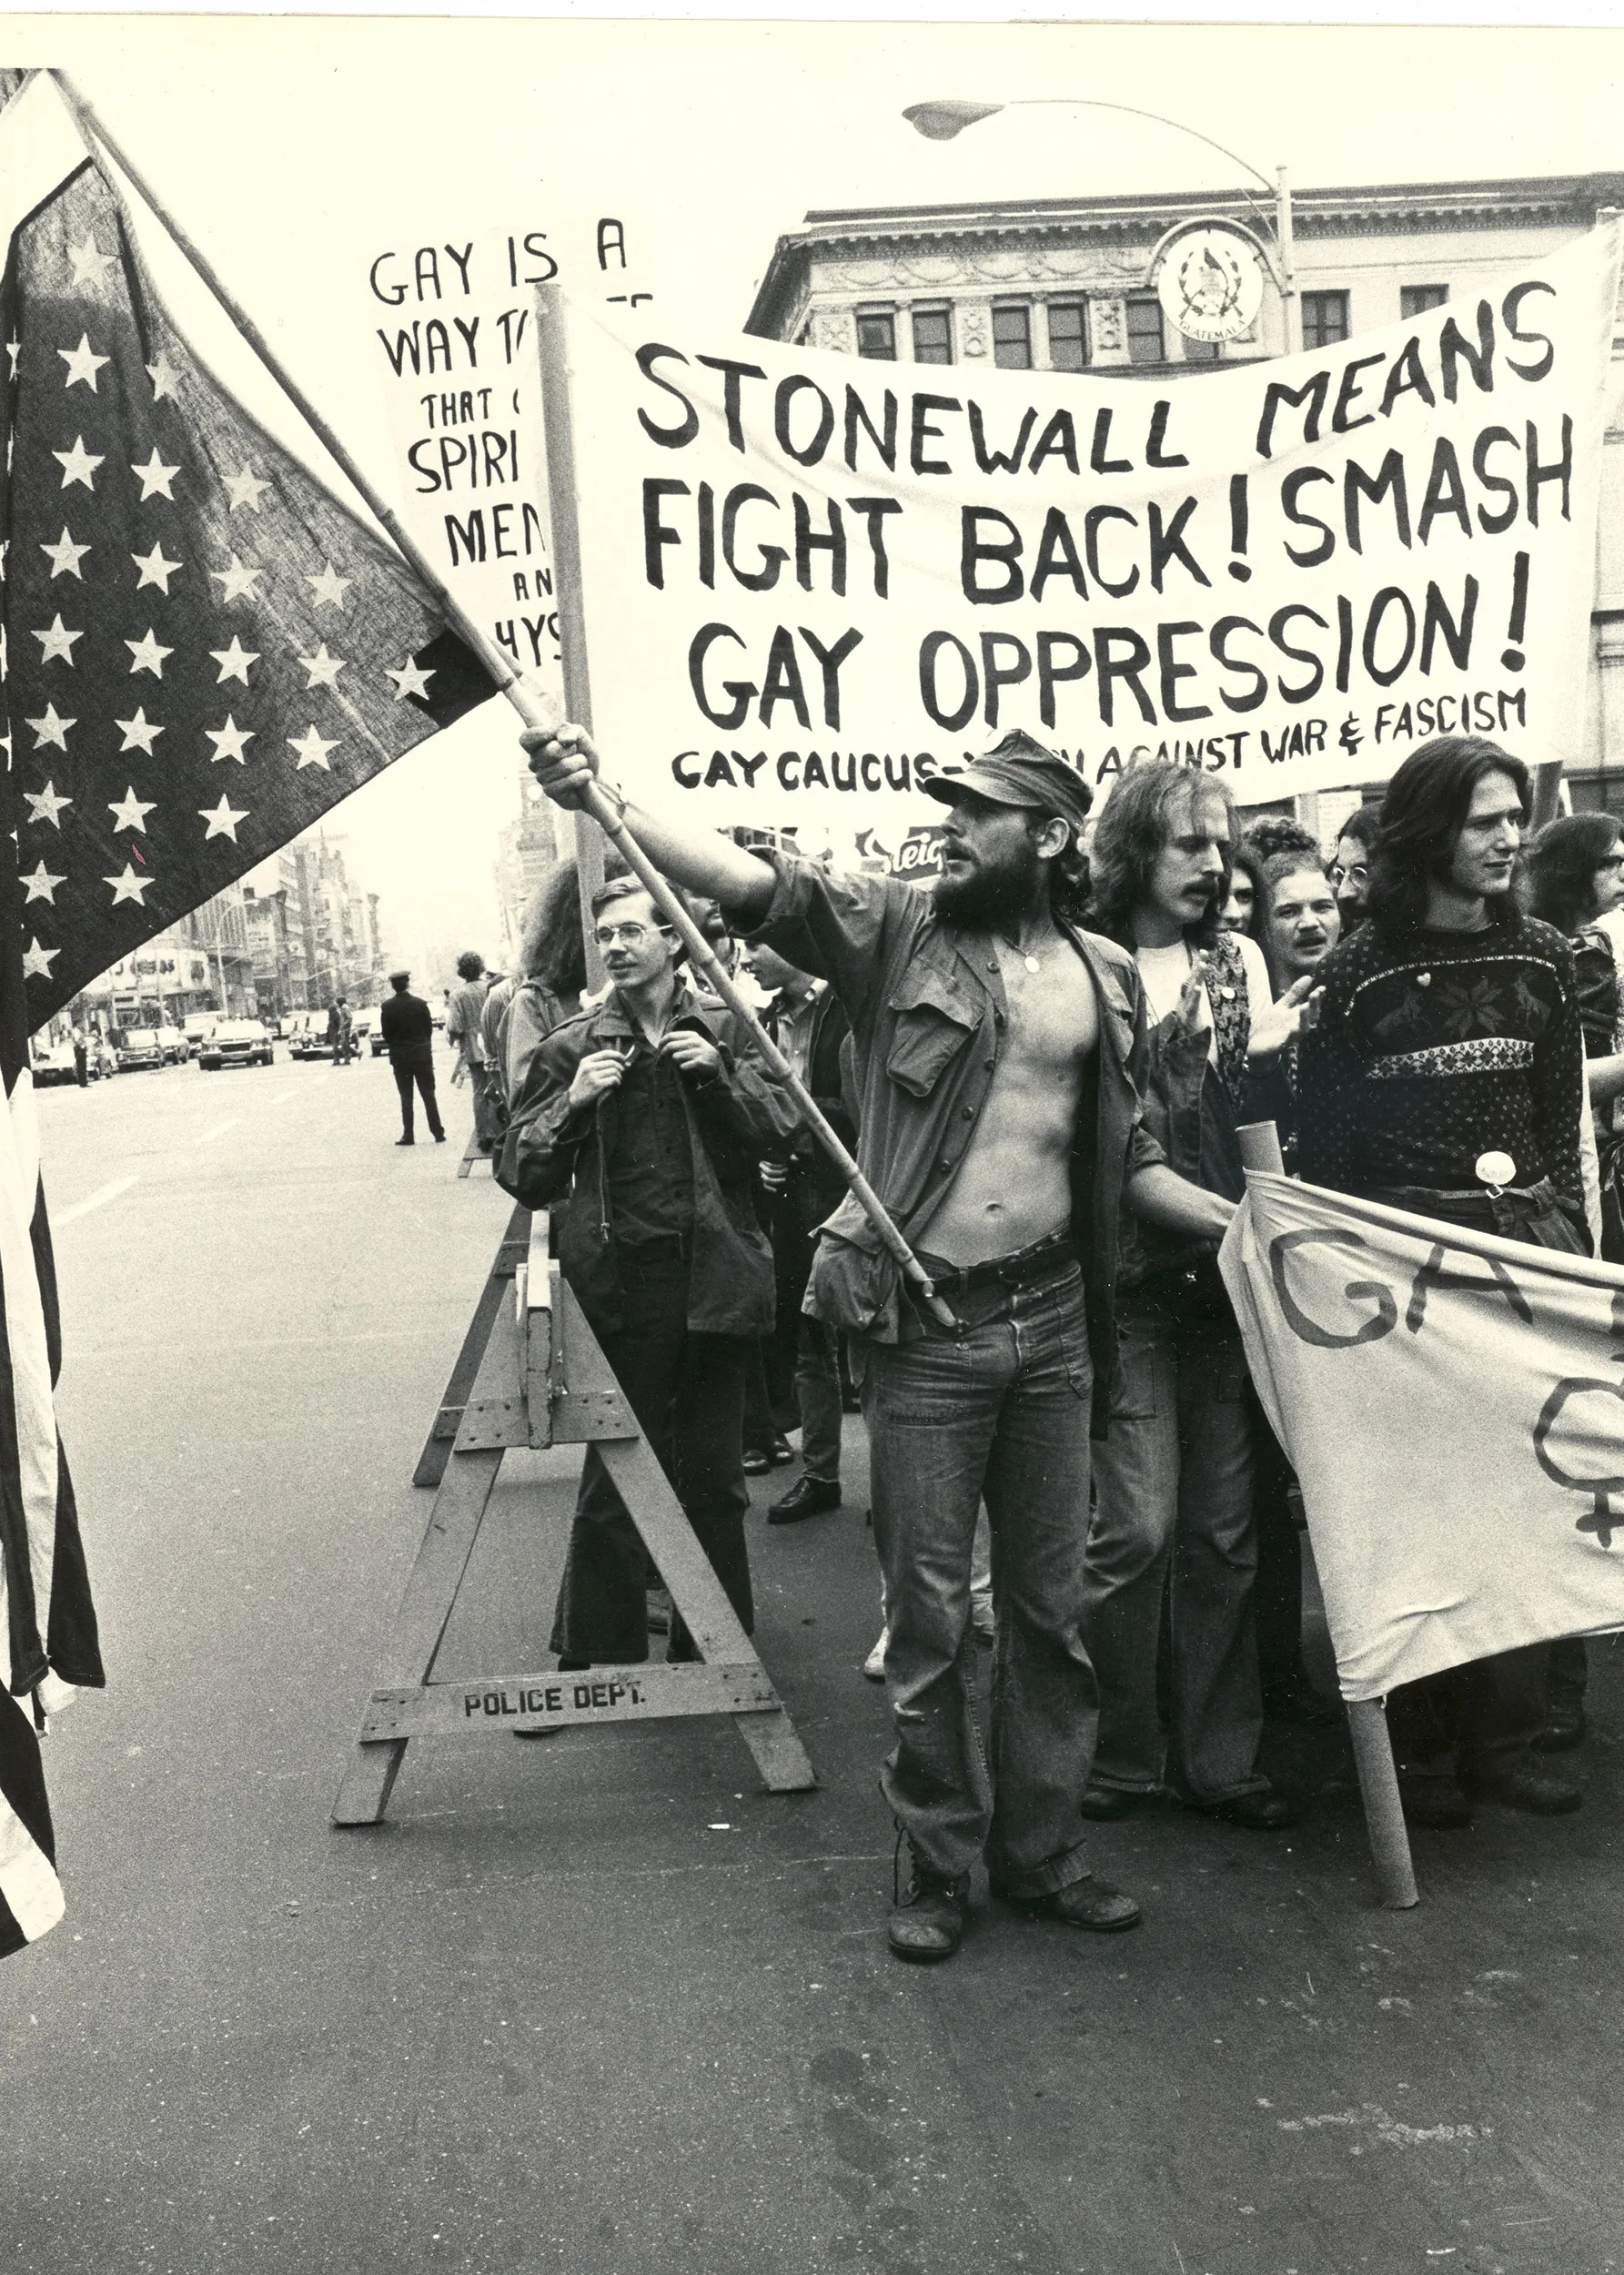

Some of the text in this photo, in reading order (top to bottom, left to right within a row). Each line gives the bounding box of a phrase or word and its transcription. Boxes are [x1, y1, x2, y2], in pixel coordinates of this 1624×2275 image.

[369, 217, 627, 306] GAY IS A
[376, 316, 479, 378] WAY
[635, 280, 1557, 476] STONEWALL MEANS
[420, 388, 492, 430] THAT
[408, 430, 519, 494] SPIRI
[444, 502, 540, 567] MEN
[642, 413, 1573, 605] FIGHT BACK! SMASH
[513, 568, 553, 602] AN
[688, 551, 1529, 733] GAY OPPRESSION!
[671, 750, 768, 790] GAY
[1260, 719, 1328, 764] WAR
[1338, 711, 1365, 757] &
[1374, 687, 1527, 744] FASCISM
[1269, 1228, 1624, 1349] GA
[464, 1681, 646, 1717] POLICE DEPT.
